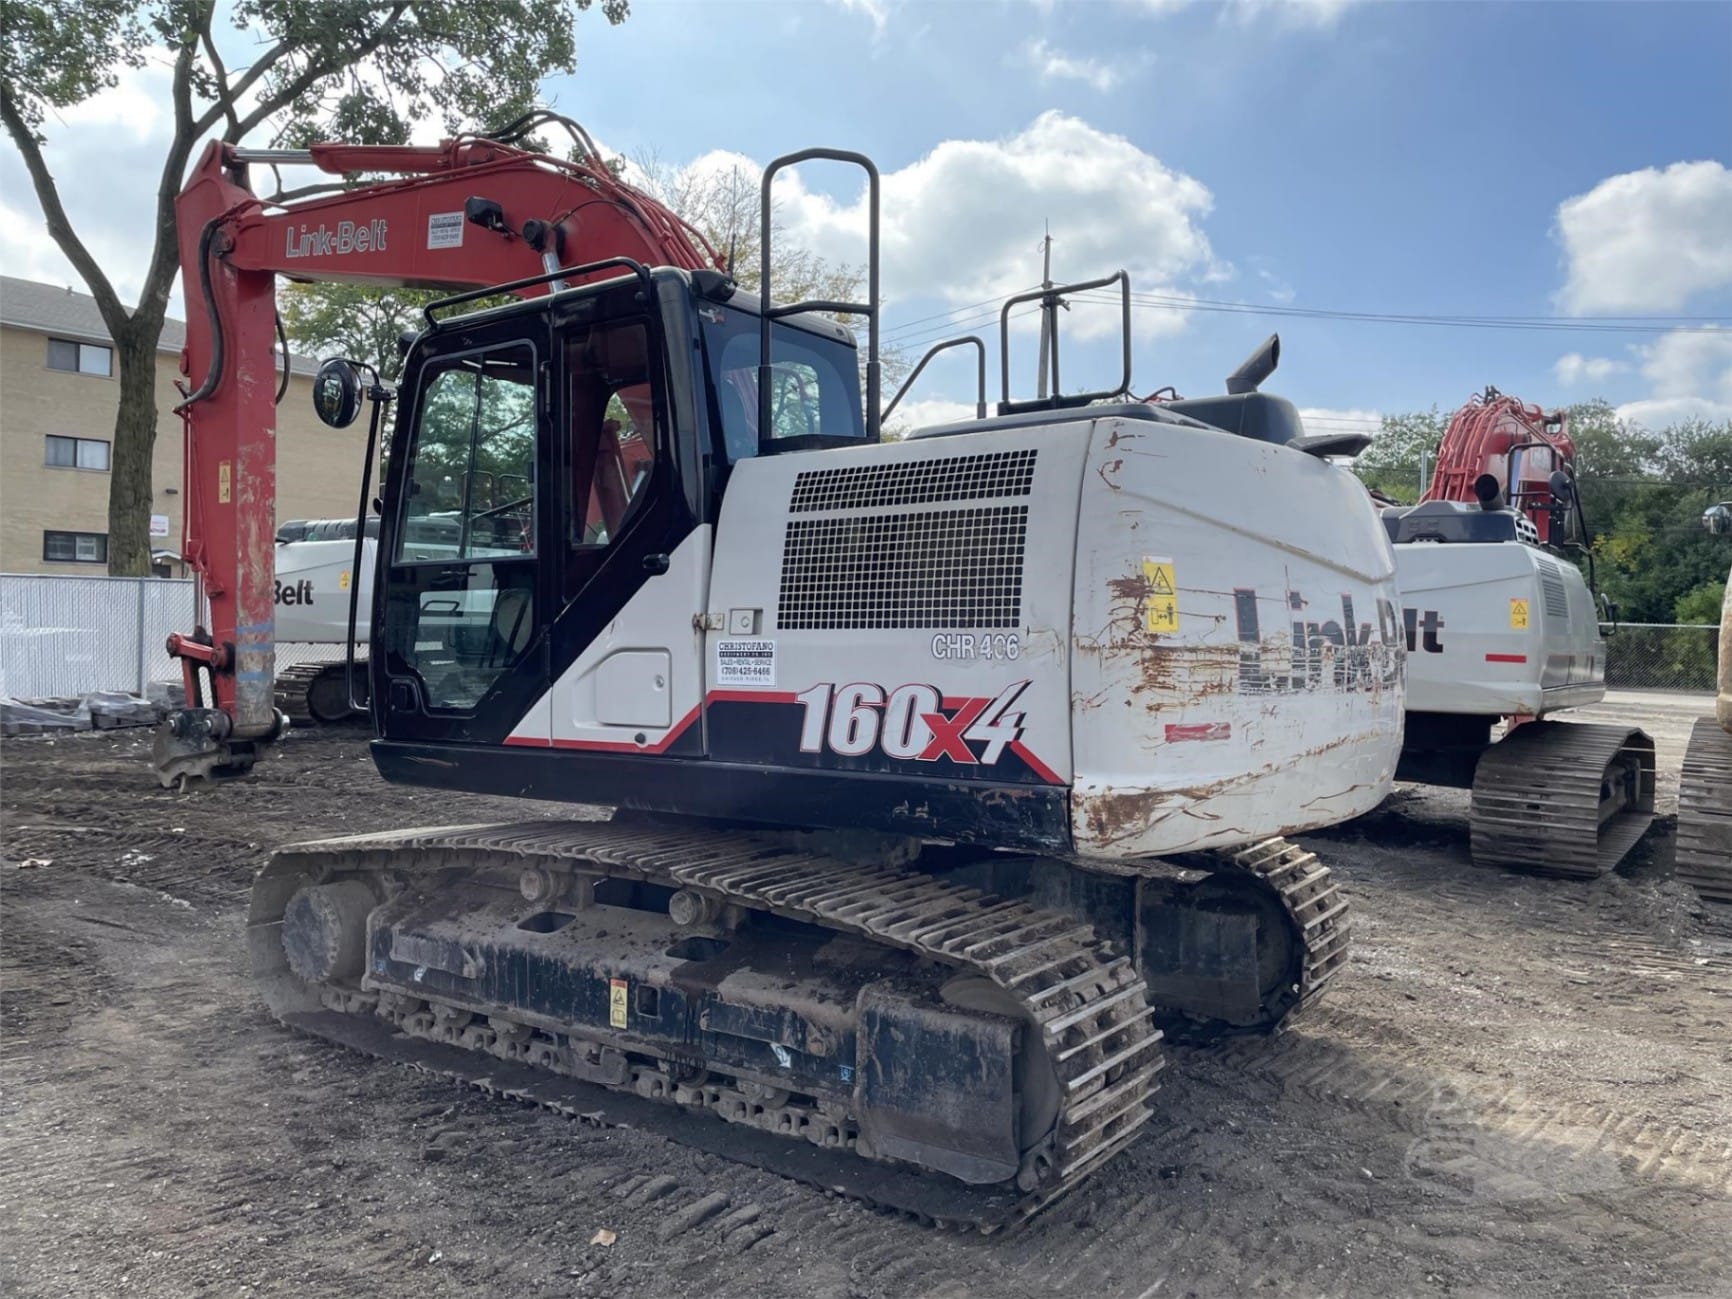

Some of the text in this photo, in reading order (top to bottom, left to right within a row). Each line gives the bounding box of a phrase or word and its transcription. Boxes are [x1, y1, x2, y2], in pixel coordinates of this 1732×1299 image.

[286, 219, 388, 258] Link-Belt
[719, 642, 773, 650] CHRISTOFANO
[931, 633, 976, 660] CHR
